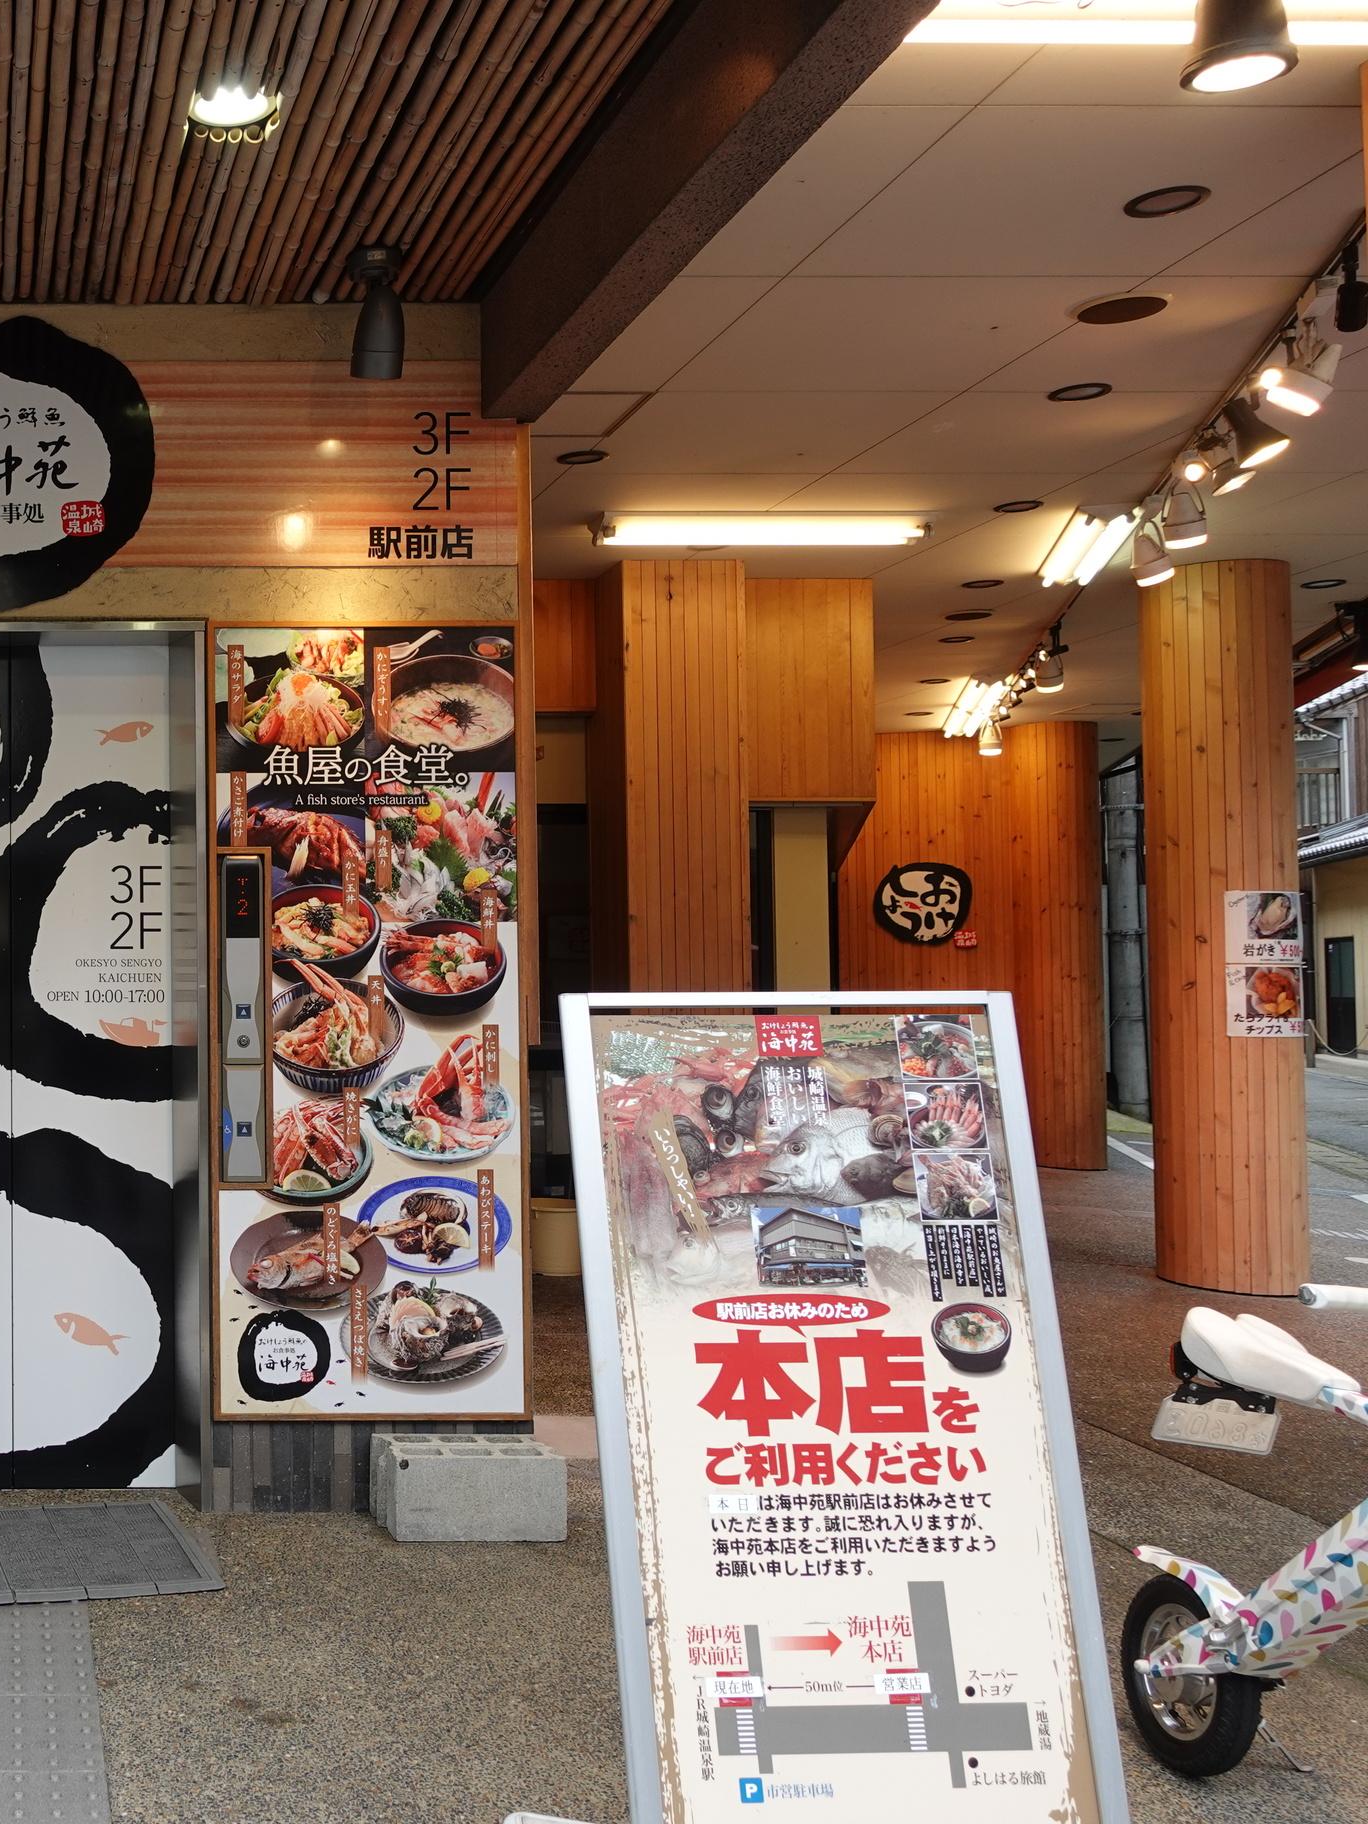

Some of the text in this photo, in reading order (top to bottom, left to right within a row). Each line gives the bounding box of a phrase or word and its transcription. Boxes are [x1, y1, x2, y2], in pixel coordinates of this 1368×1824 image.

[412, 411, 472, 456] 3F
[412, 467, 472, 511] 2F
[367, 524, 474, 560] 駅前店
[229, 648, 243, 704] 海のサラダ
[376, 651, 389, 717] かにぞうすい
[263, 744, 470, 787] 魚屋の食堂。
[232, 774, 245, 838] かさご煮付け
[295, 793, 429, 806] A fish store's restaurant.
[376, 834, 390, 867] 舟盛り
[110, 865, 163, 904] 3F
[344, 860, 357, 904] かに玉丼
[482, 895, 495, 929] 海鮮丼
[110, 911, 163, 949] 2F
[75, 958, 163, 968] OKESYO SENGYO
[1242, 943, 1277, 957] 岩がき
[98, 972, 162, 983] KAICHUEN
[370, 979, 382, 1006] 天丼
[46, 988, 165, 1004] OPEN 10:00-17:00
[484, 1028, 497, 1073] かに刺し
[760, 1031, 819, 1053] 海中苑
[764, 1065, 787, 1130] 海鮮食堂
[786, 1065, 807, 1125] おいしい
[806, 1065, 829, 1127] 城崎温泉
[345, 1090, 358, 1136] 焼きがに
[479, 1175, 492, 1255] あわびステーキ
[326, 1206, 338, 1286] のどぐろ塩焼き
[352, 1287, 365, 1369] さざえつぼ焼き
[715, 1301, 869, 1321] 駅前店お休みのため
[258, 1353, 310, 1373] 海中苑
[693, 1327, 982, 1438] 本店を
[703, 1440, 988, 1489] ご利用ください
[711, 1535, 998, 1556] 海中苑本店をご利用いただきますよう
[715, 1558, 875, 1578] お願い申し上げます。
[686, 1625, 743, 1645] 海中苑
[846, 1614, 912, 1639] 海中苑
[687, 1646, 744, 1666] 駅前店
[861, 1640, 905, 1664] 本店
[714, 1680, 755, 1695] 現在地
[881, 1676, 922, 1692] 営業店
[967, 1669, 1019, 1681] スーパー
[695, 1685, 715, 1782] JR城崎温泉駅
[1035, 1709, 1052, 1751] 地蔵湯
[766, 1782, 835, 1800] 市営駐車場
[971, 1771, 1047, 1786] よしはる旅館
